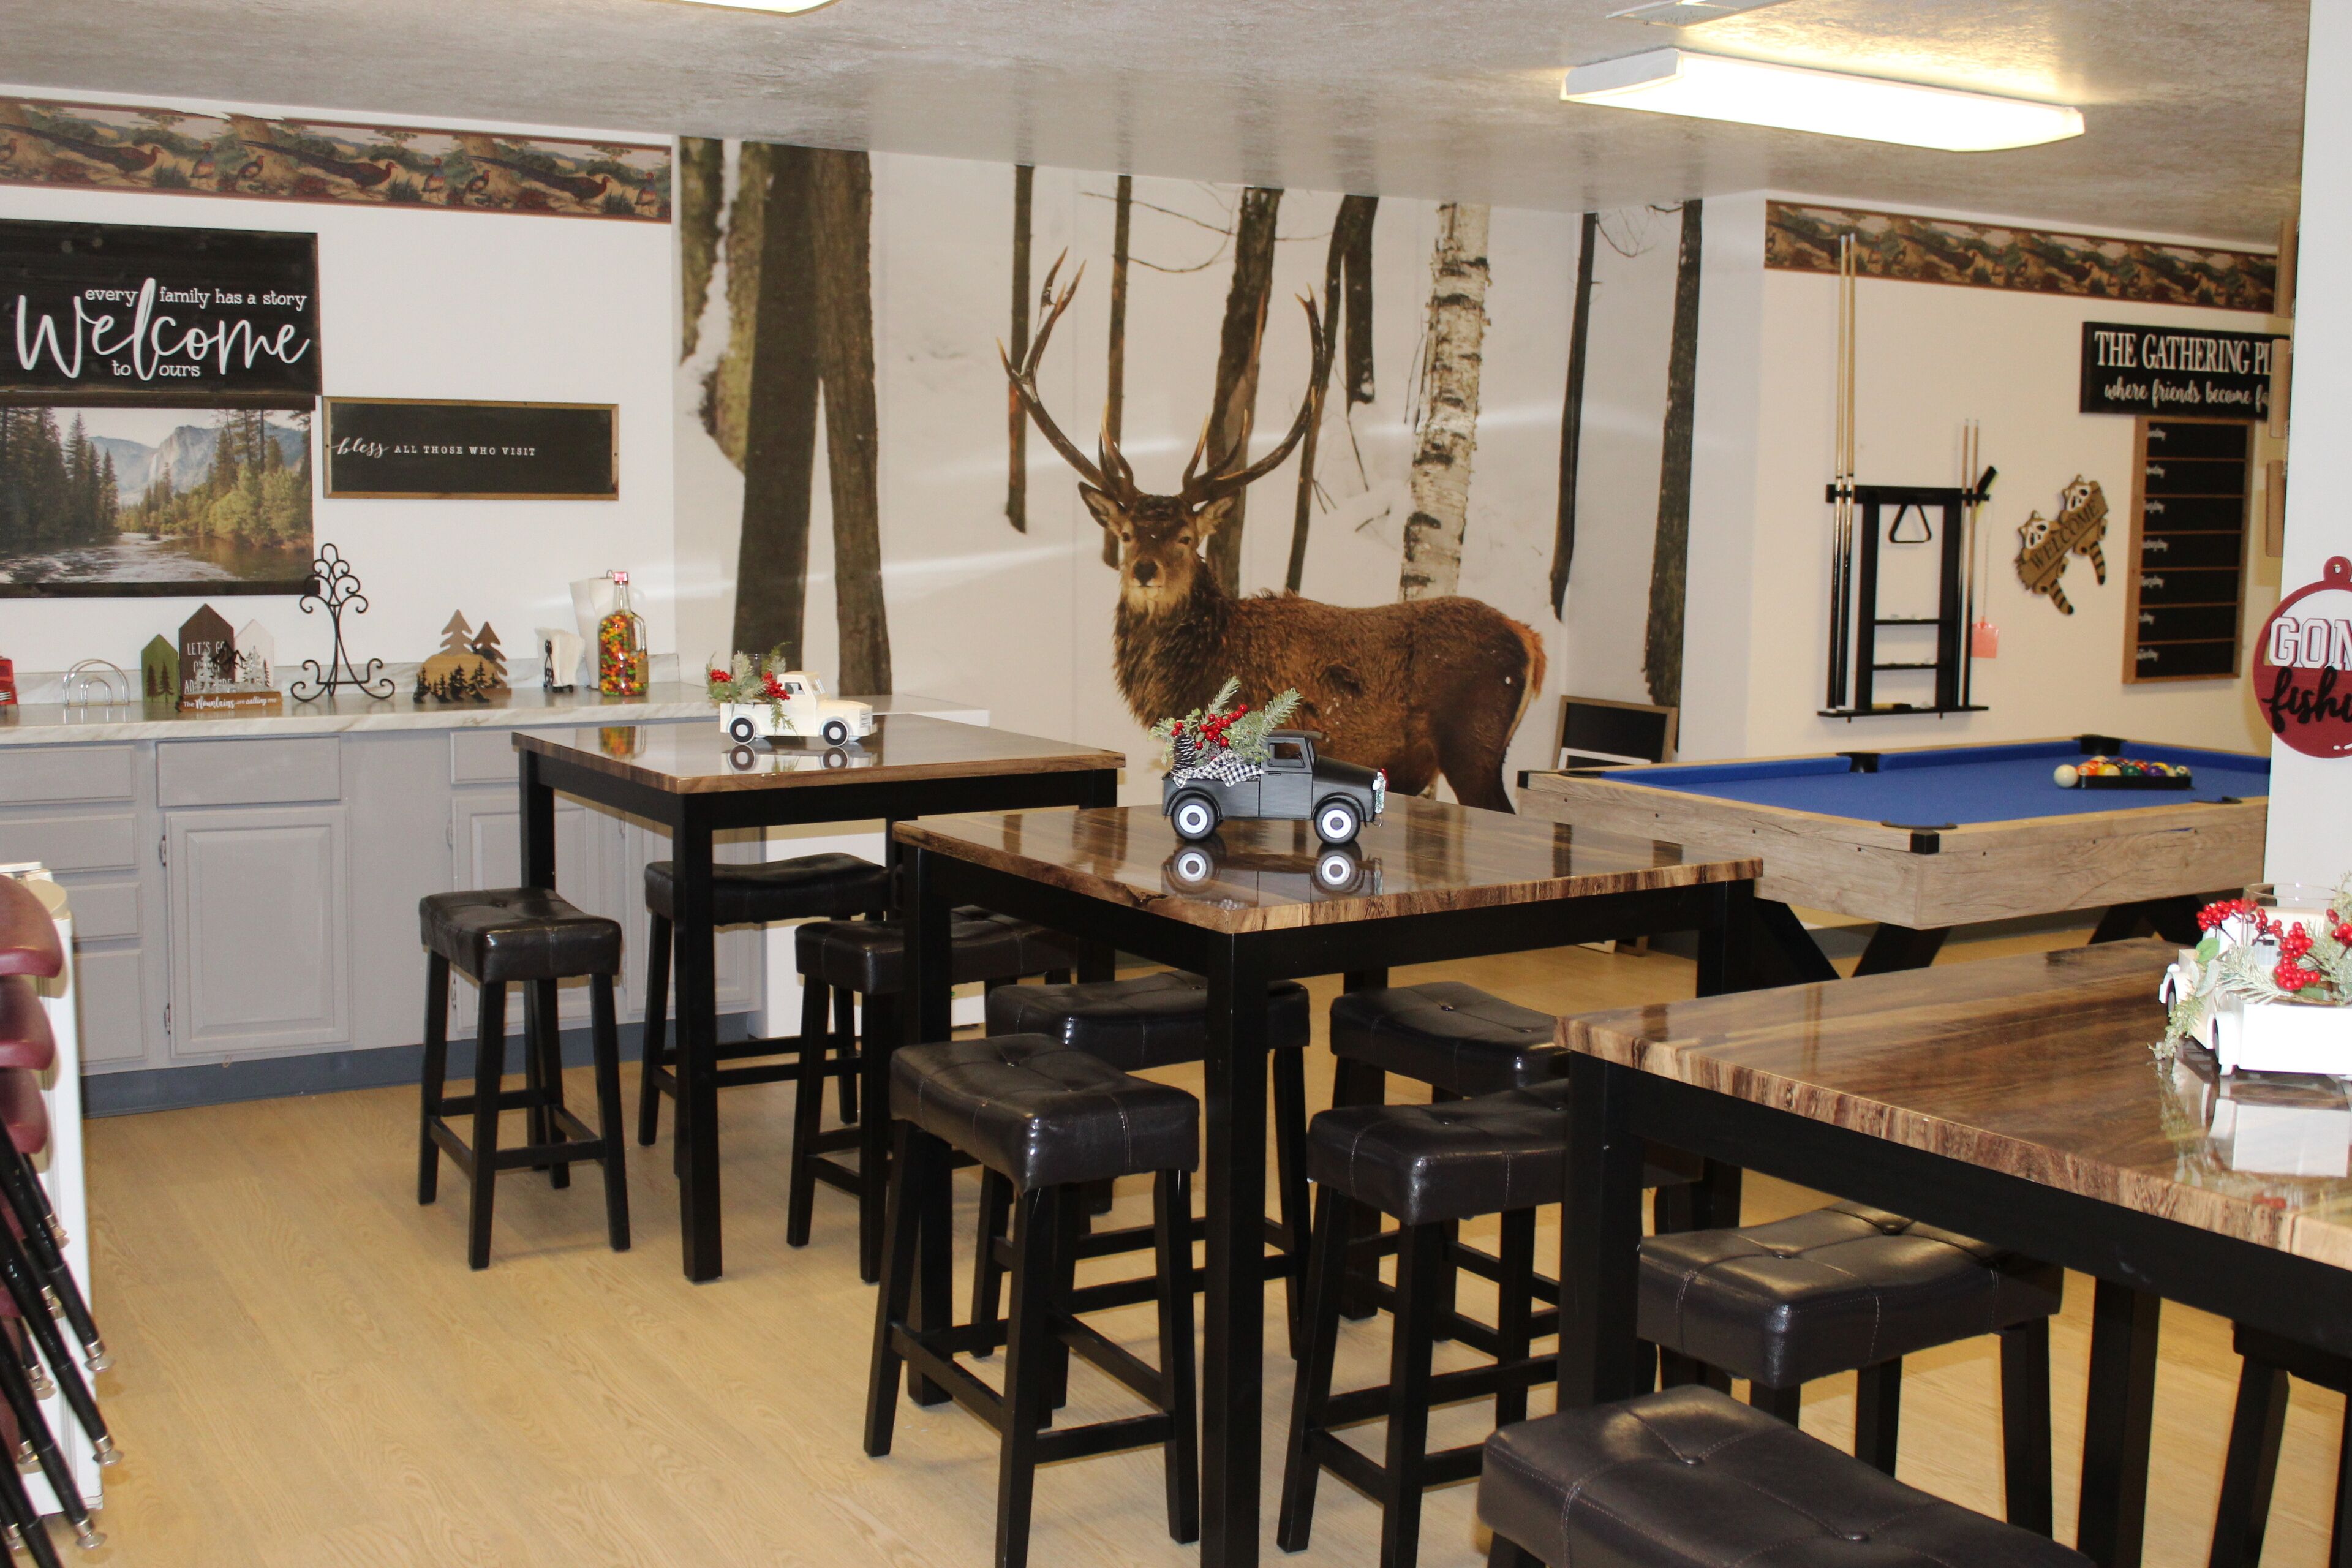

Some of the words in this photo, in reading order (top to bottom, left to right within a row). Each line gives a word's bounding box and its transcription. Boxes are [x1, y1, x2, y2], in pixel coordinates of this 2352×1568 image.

[85, 288, 138, 307] every
[159, 287, 210, 309] family
[215, 289, 243, 305] has
[247, 292, 257, 305] a
[262, 291, 307, 311] story
[2094, 331, 2138, 368] THE
[2142, 334, 2251, 375] GATHERING
[111, 360, 131, 377] to
[159, 364, 201, 378] ours
[2105, 375, 2148, 401] where
[2152, 378, 2201, 409] friends
[2206, 380, 2252, 405] become
[331, 436, 389, 459] bless
[394, 445, 417, 454] ALL
[423, 446, 463, 455] THOSE
[469, 447, 496, 456] WHO
[502, 447, 537, 456] VISIT
[2031, 501, 2097, 568] WELCOME
[246, 696, 266, 706] calling
